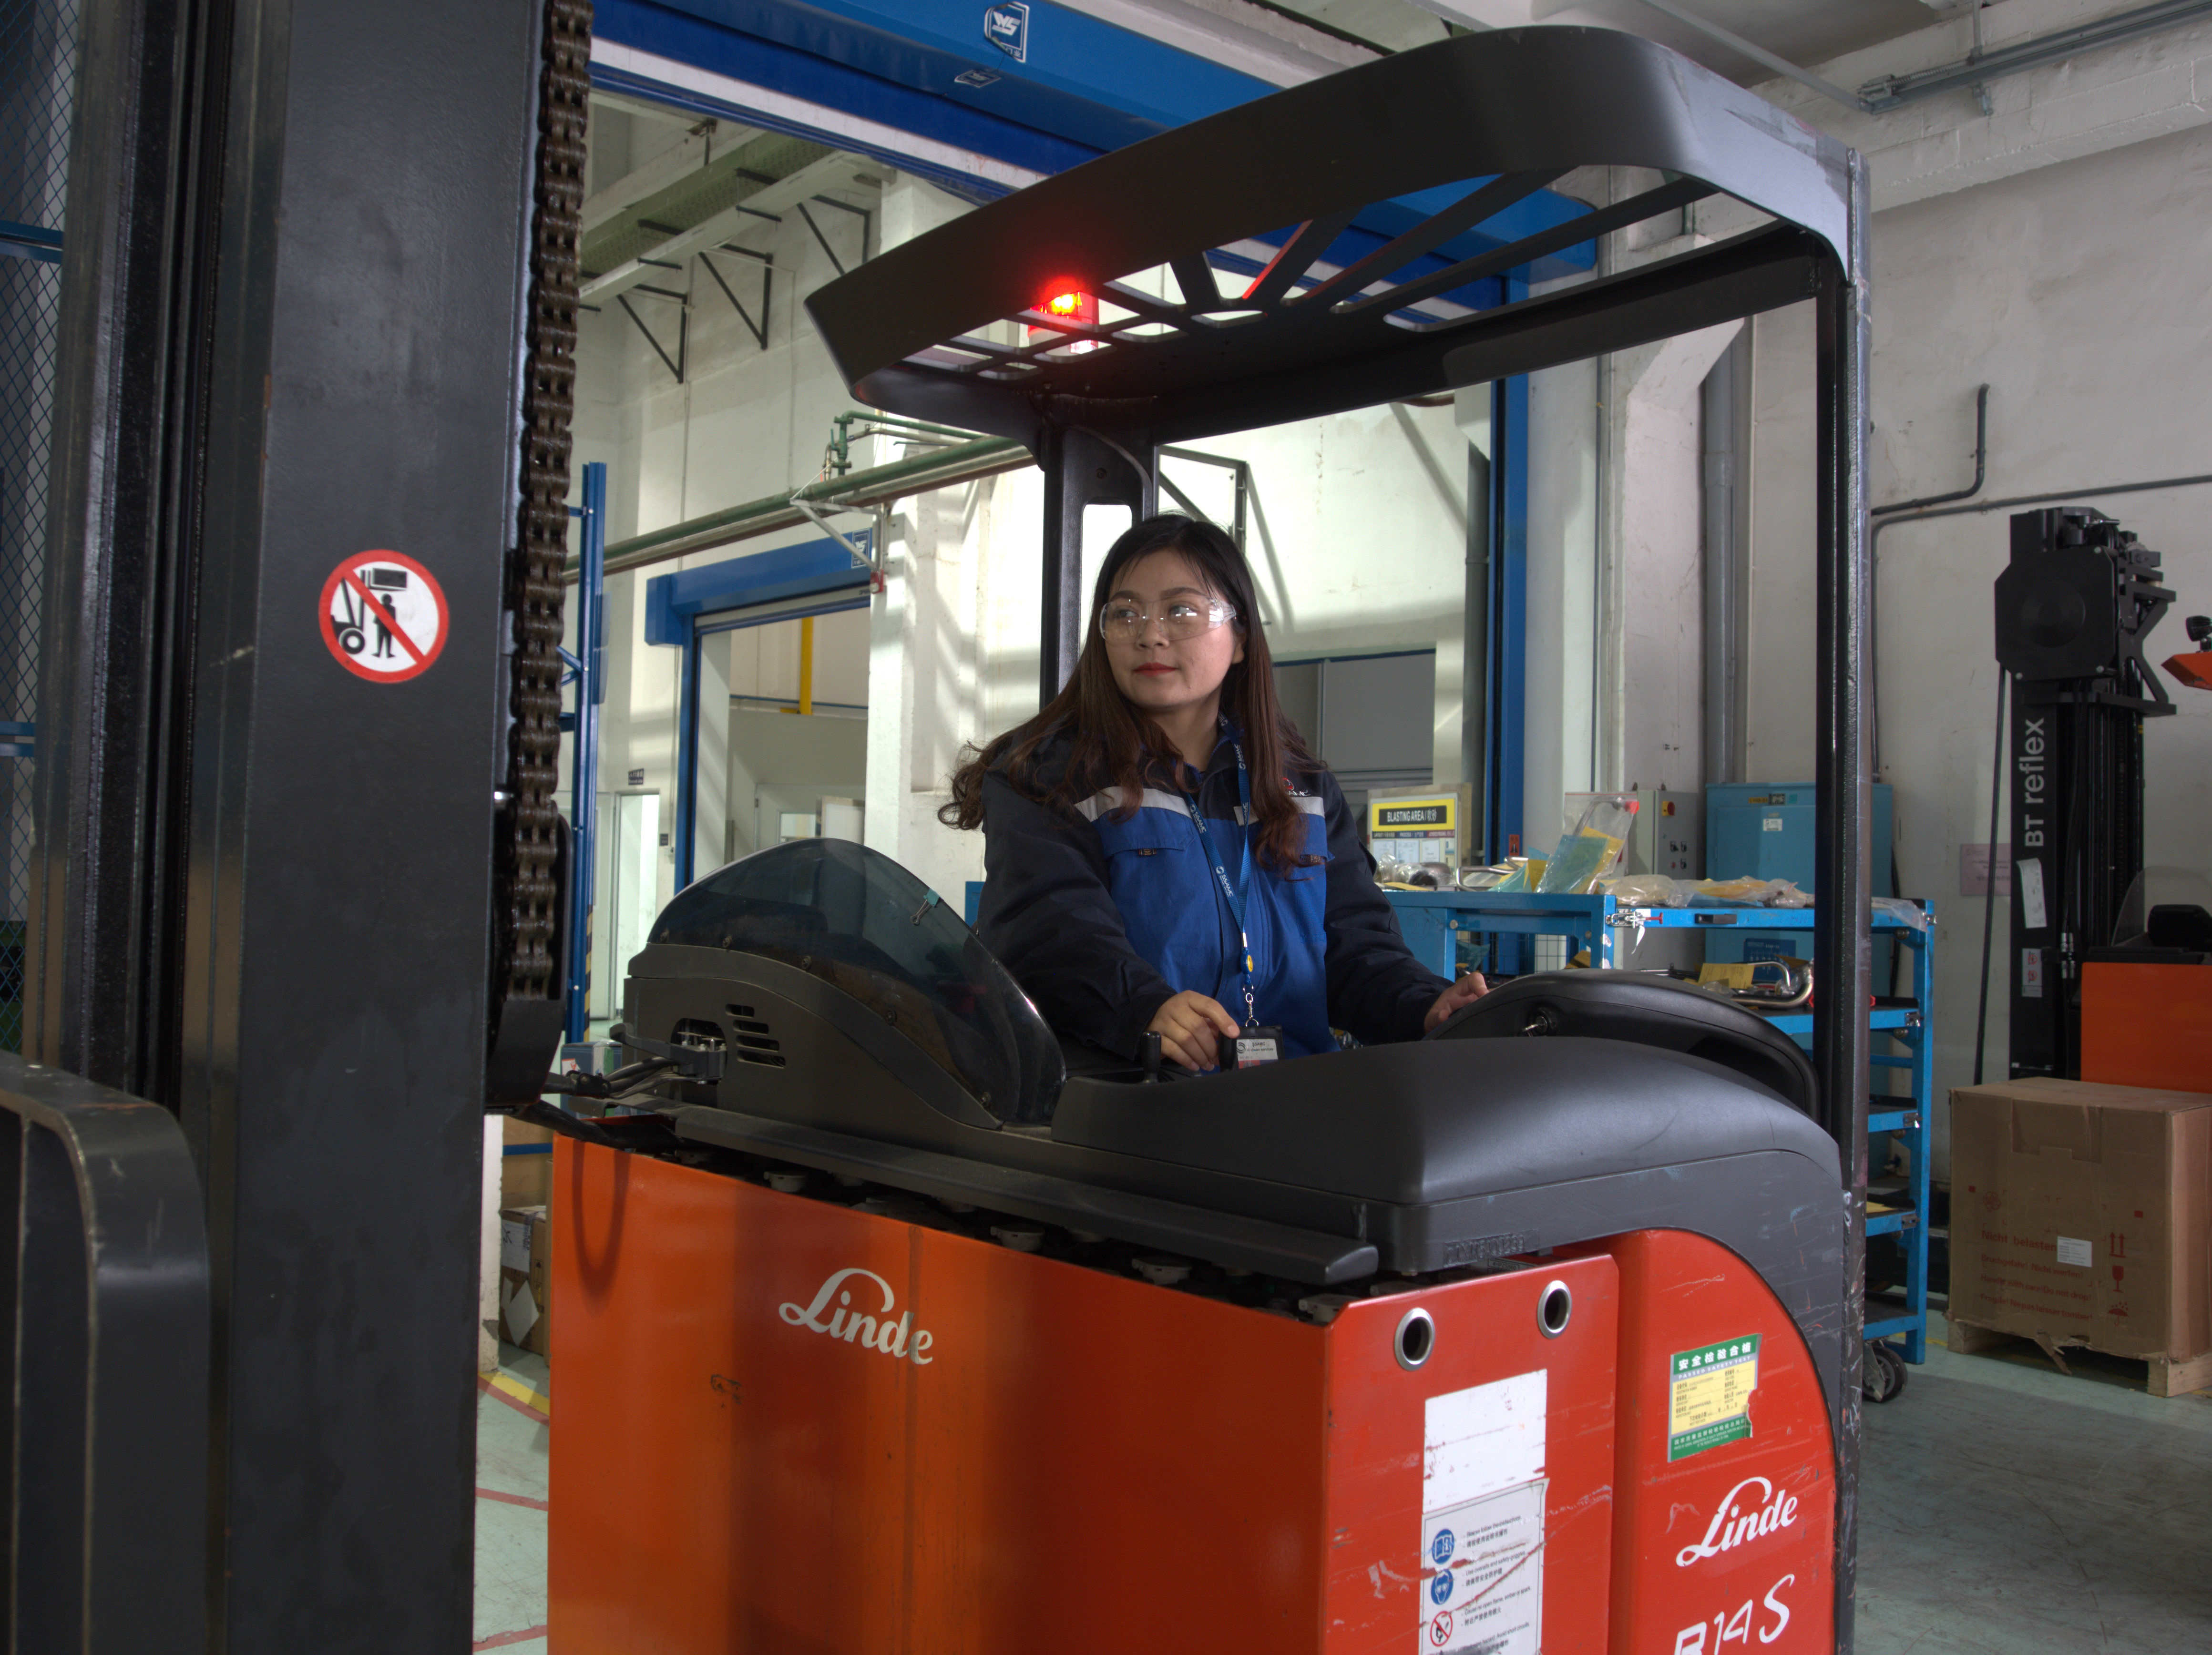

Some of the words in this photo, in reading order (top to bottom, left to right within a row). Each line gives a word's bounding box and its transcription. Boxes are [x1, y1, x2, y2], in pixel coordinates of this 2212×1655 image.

[2019, 717, 2045, 803] reflex
[1387, 811, 1410, 822] BLASTING
[1411, 810, 1424, 821] AREA
[2025, 814, 2044, 847] BT
[1981, 1230, 2008, 1243] Nicht
[778, 1268, 933, 1365] Linde
[1678, 1342, 1751, 1371] 安全检验合格
[1679, 1369, 1705, 1380] PASSED
[1707, 1360, 1733, 1372] SAFETY
[1735, 1356, 1751, 1364] TEST
[1676, 1476, 1797, 1567] Linde
